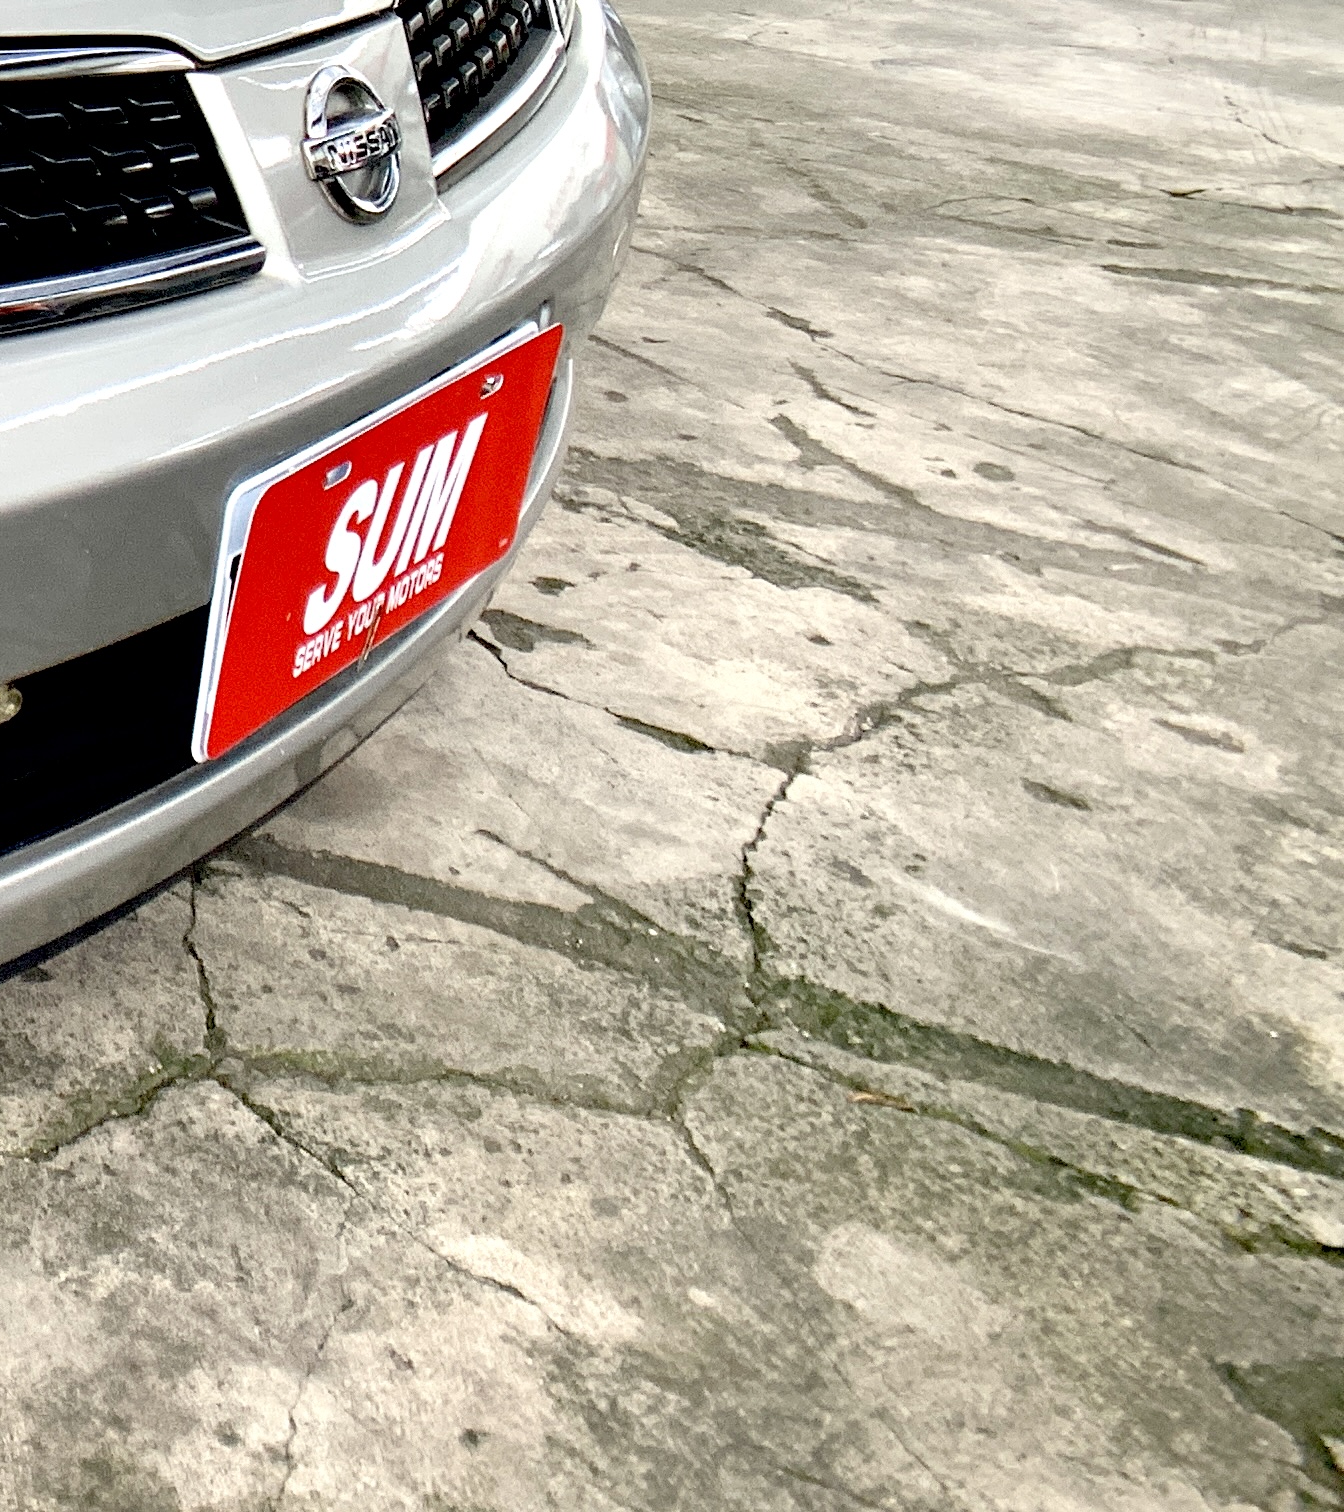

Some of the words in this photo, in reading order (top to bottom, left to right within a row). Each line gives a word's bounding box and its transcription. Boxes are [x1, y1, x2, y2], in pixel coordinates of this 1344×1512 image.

[303, 412, 489, 635] SUM
[292, 625, 343, 679] SERVE
[385, 552, 444, 615] MOTORS
